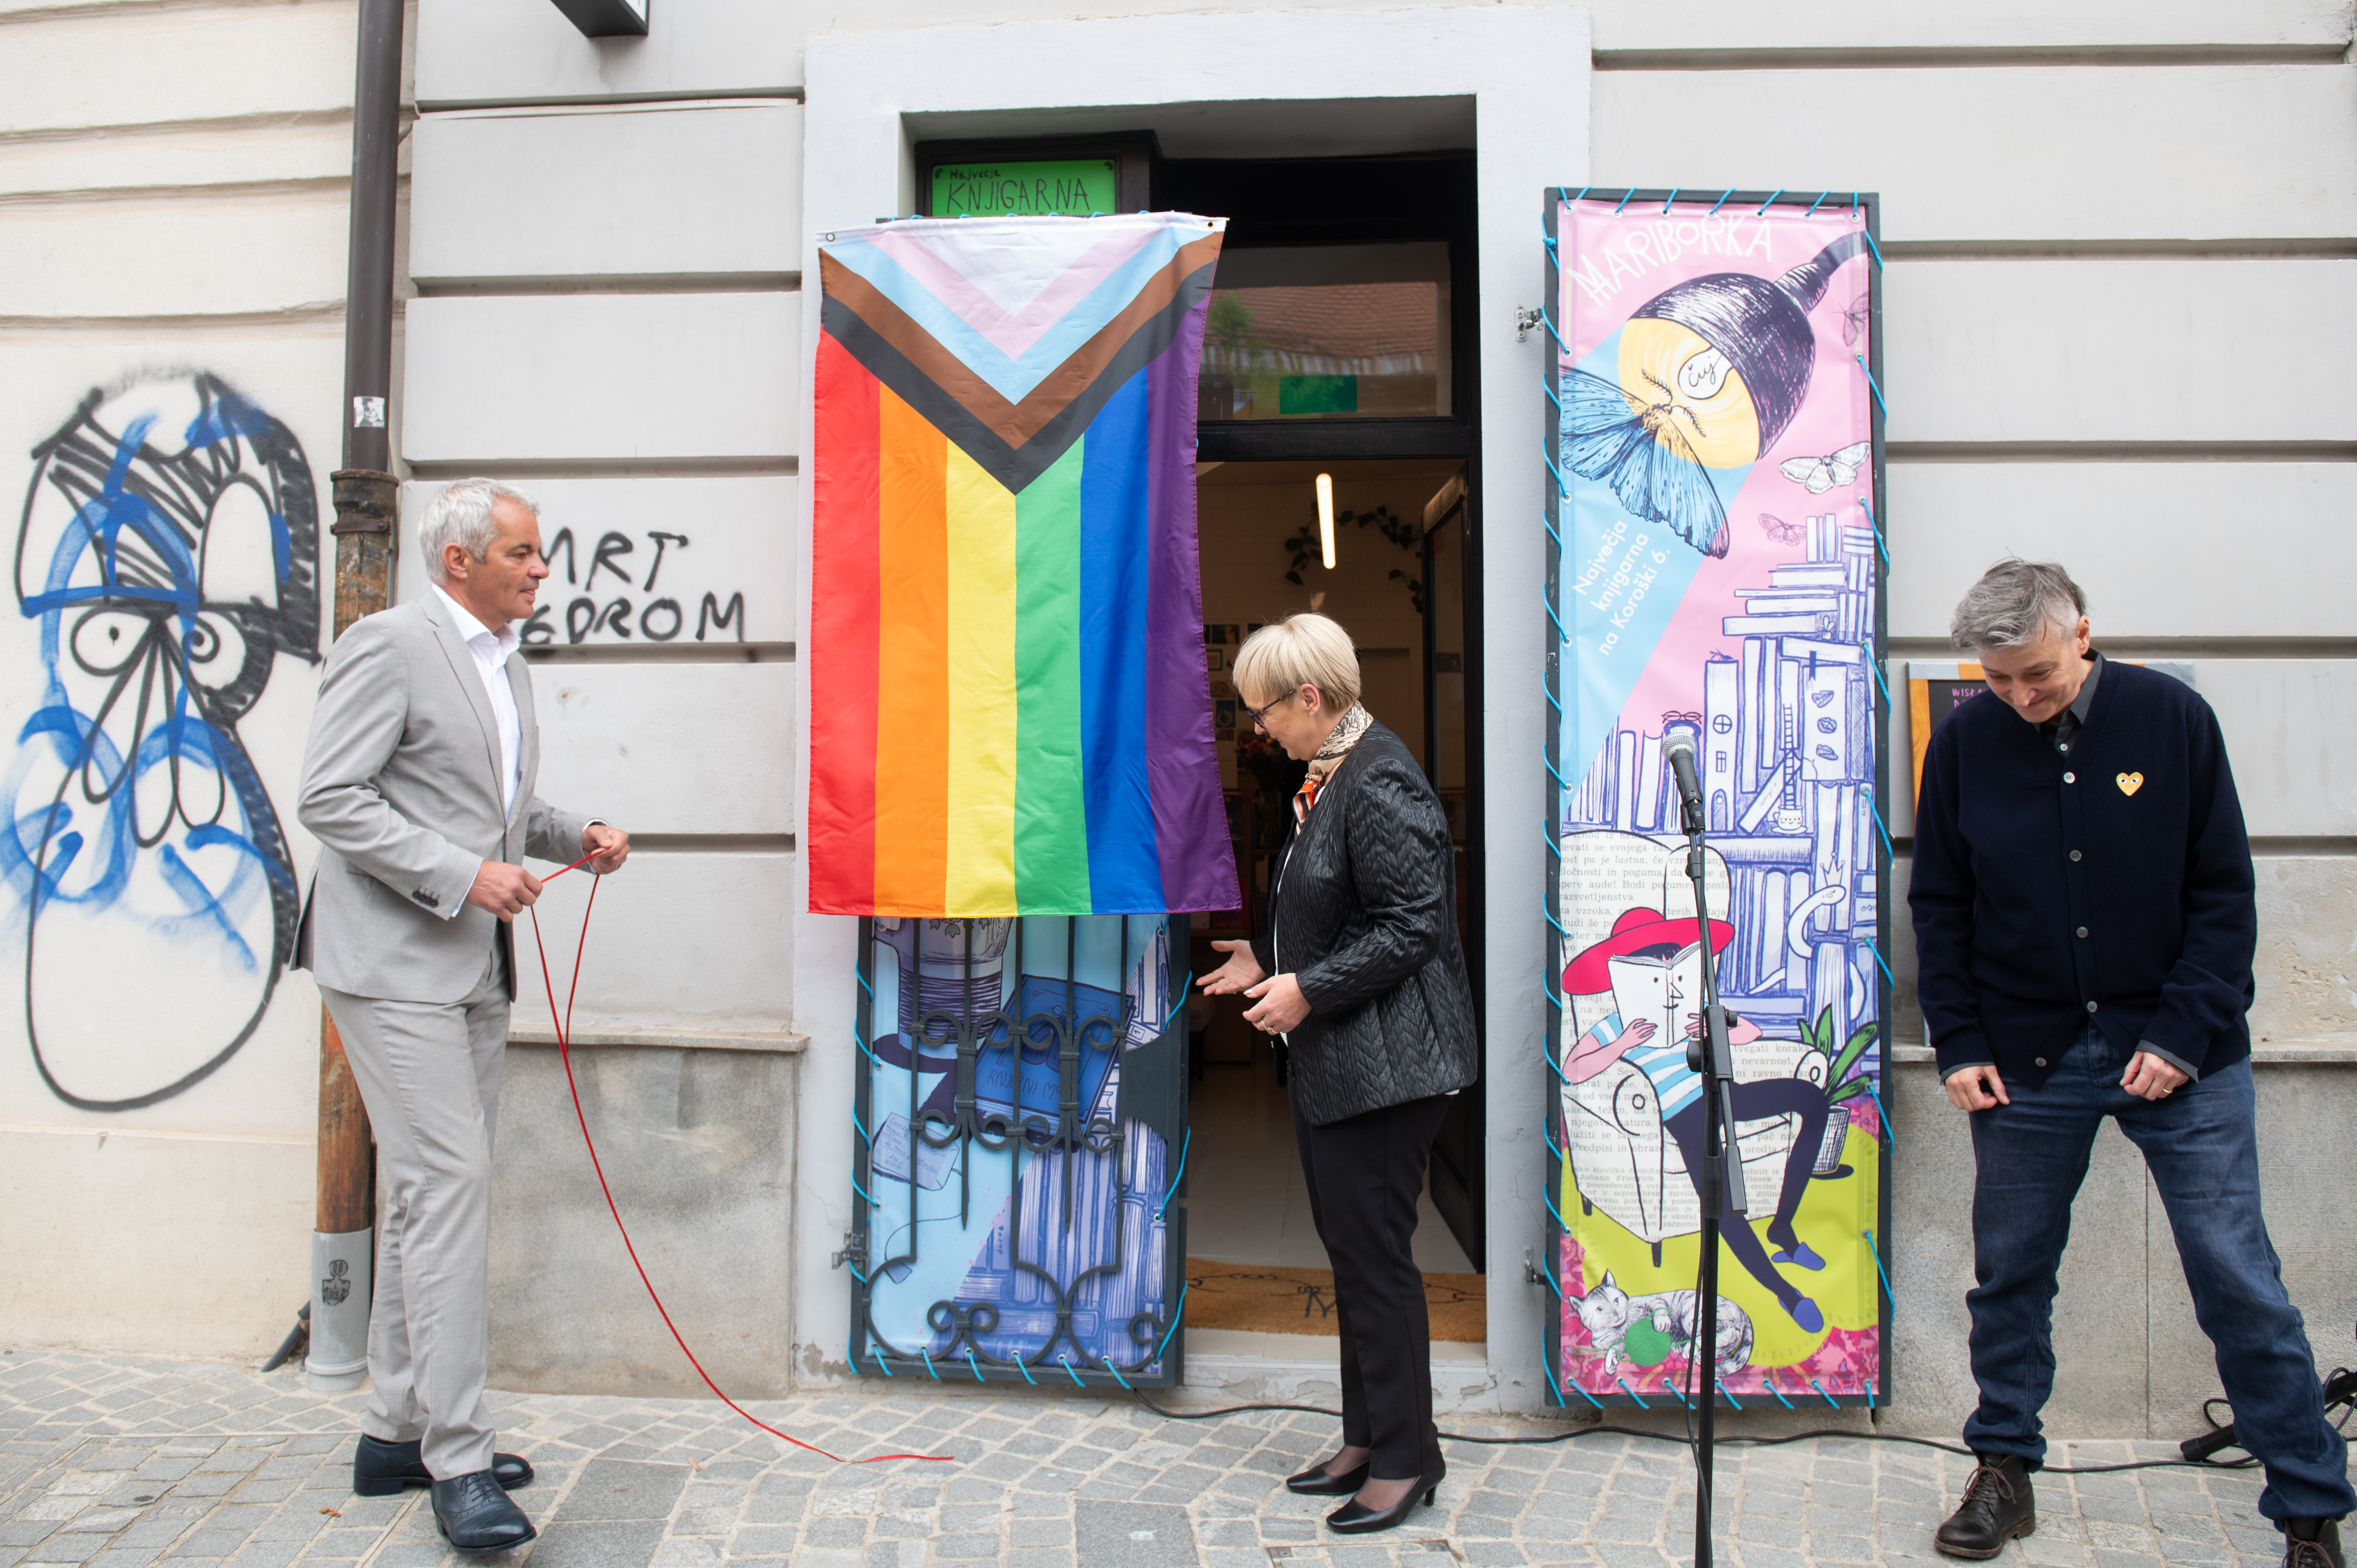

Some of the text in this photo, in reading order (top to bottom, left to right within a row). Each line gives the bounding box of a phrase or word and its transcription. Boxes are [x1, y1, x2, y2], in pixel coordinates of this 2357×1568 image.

[946, 178, 1090, 214] KNJIGARNA
[1565, 214, 1772, 308] MARIBORKA
[1572, 520, 1627, 595] Največja
[1590, 533, 1649, 613] knjigarna
[1598, 635, 1618, 655] na
[1613, 568, 1657, 629] Koroški
[1610, 843, 1647, 854] svojega
[1583, 856, 1595, 865] pa
[1600, 855, 1610, 865] je
[1615, 855, 1648, 865] lastna,
[1652, 856, 1664, 864] če
[1607, 868, 1617, 876] in
[1671, 868, 1683, 877] da
[1589, 880, 1616, 889] aude!
[1622, 880, 1645, 889] Bodi
[1576, 906, 1613, 916] vzroka,
[1563, 919, 1584, 927] tudi
[1588, 919, 1599, 927] še
[1583, 1091, 1595, 1100] od
[1757, 1132, 1774, 1142] pač
